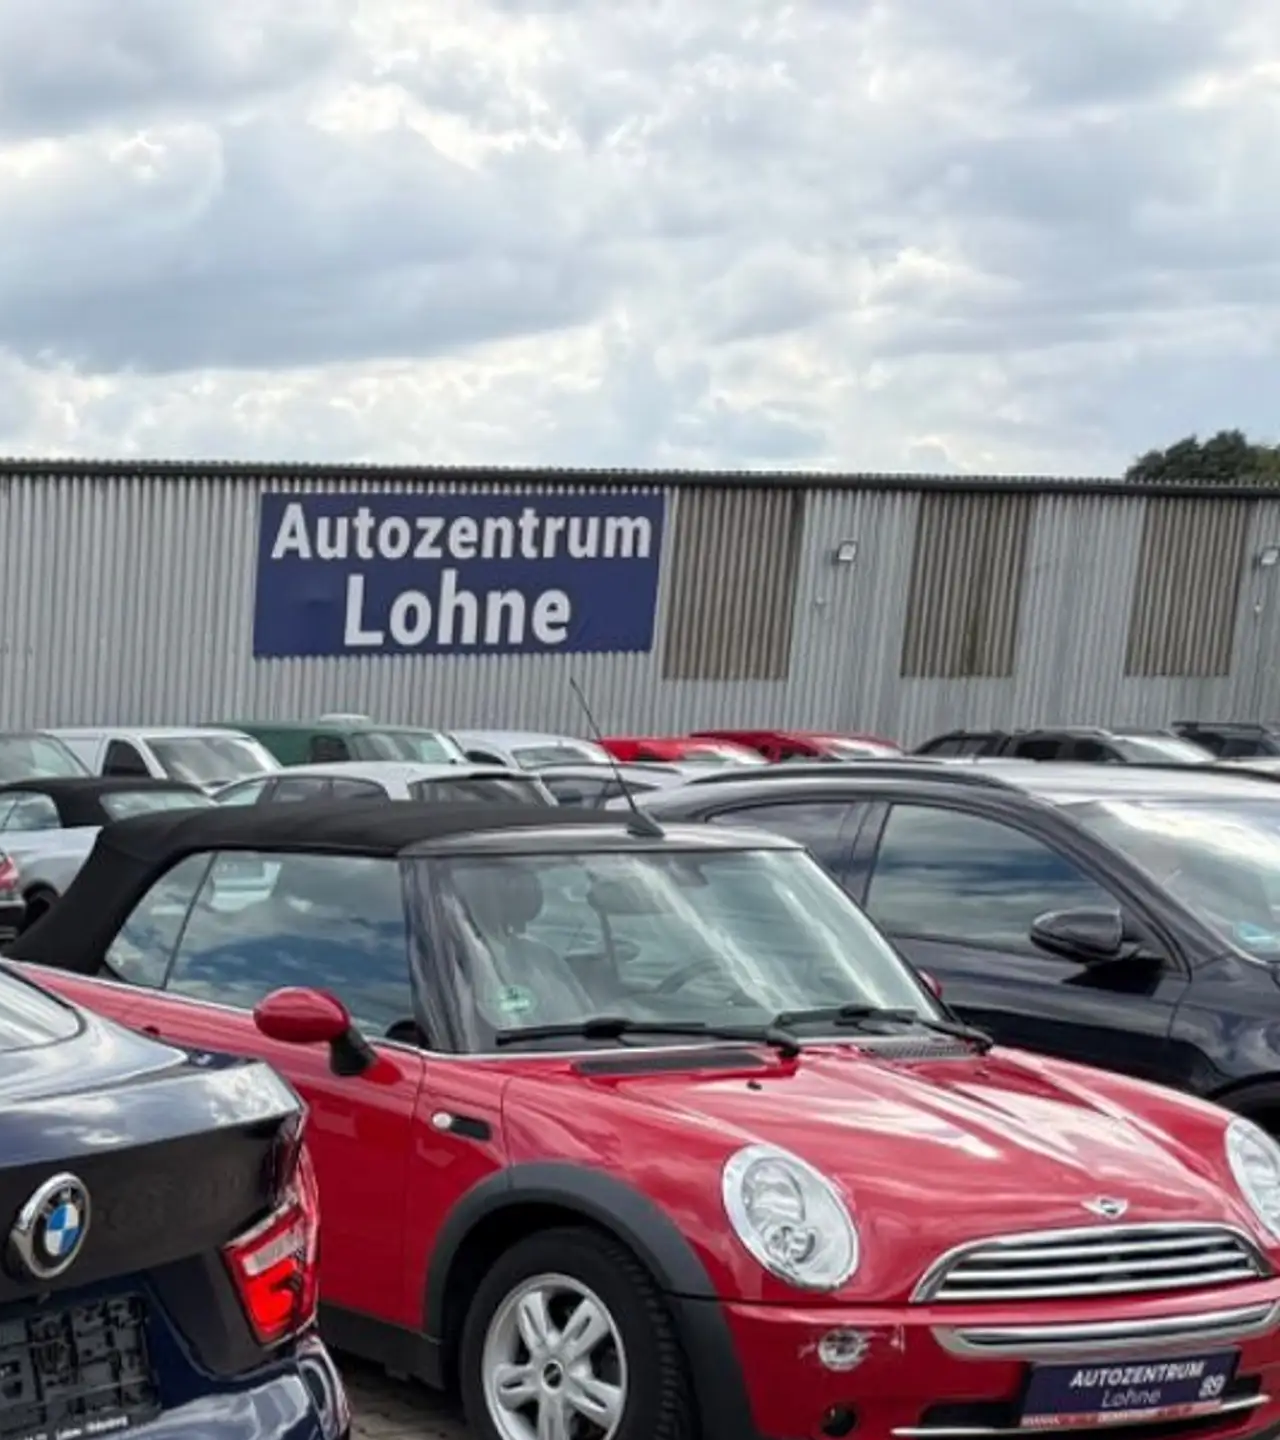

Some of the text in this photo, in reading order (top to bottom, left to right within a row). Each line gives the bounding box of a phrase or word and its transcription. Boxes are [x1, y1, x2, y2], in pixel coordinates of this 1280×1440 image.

[271, 502, 652, 560] Autozentrum
[344, 567, 572, 646] Lohne
[1069, 1361, 1206, 1388] AUTOZENTRUM
[1100, 1387, 1162, 1408] Lohne
